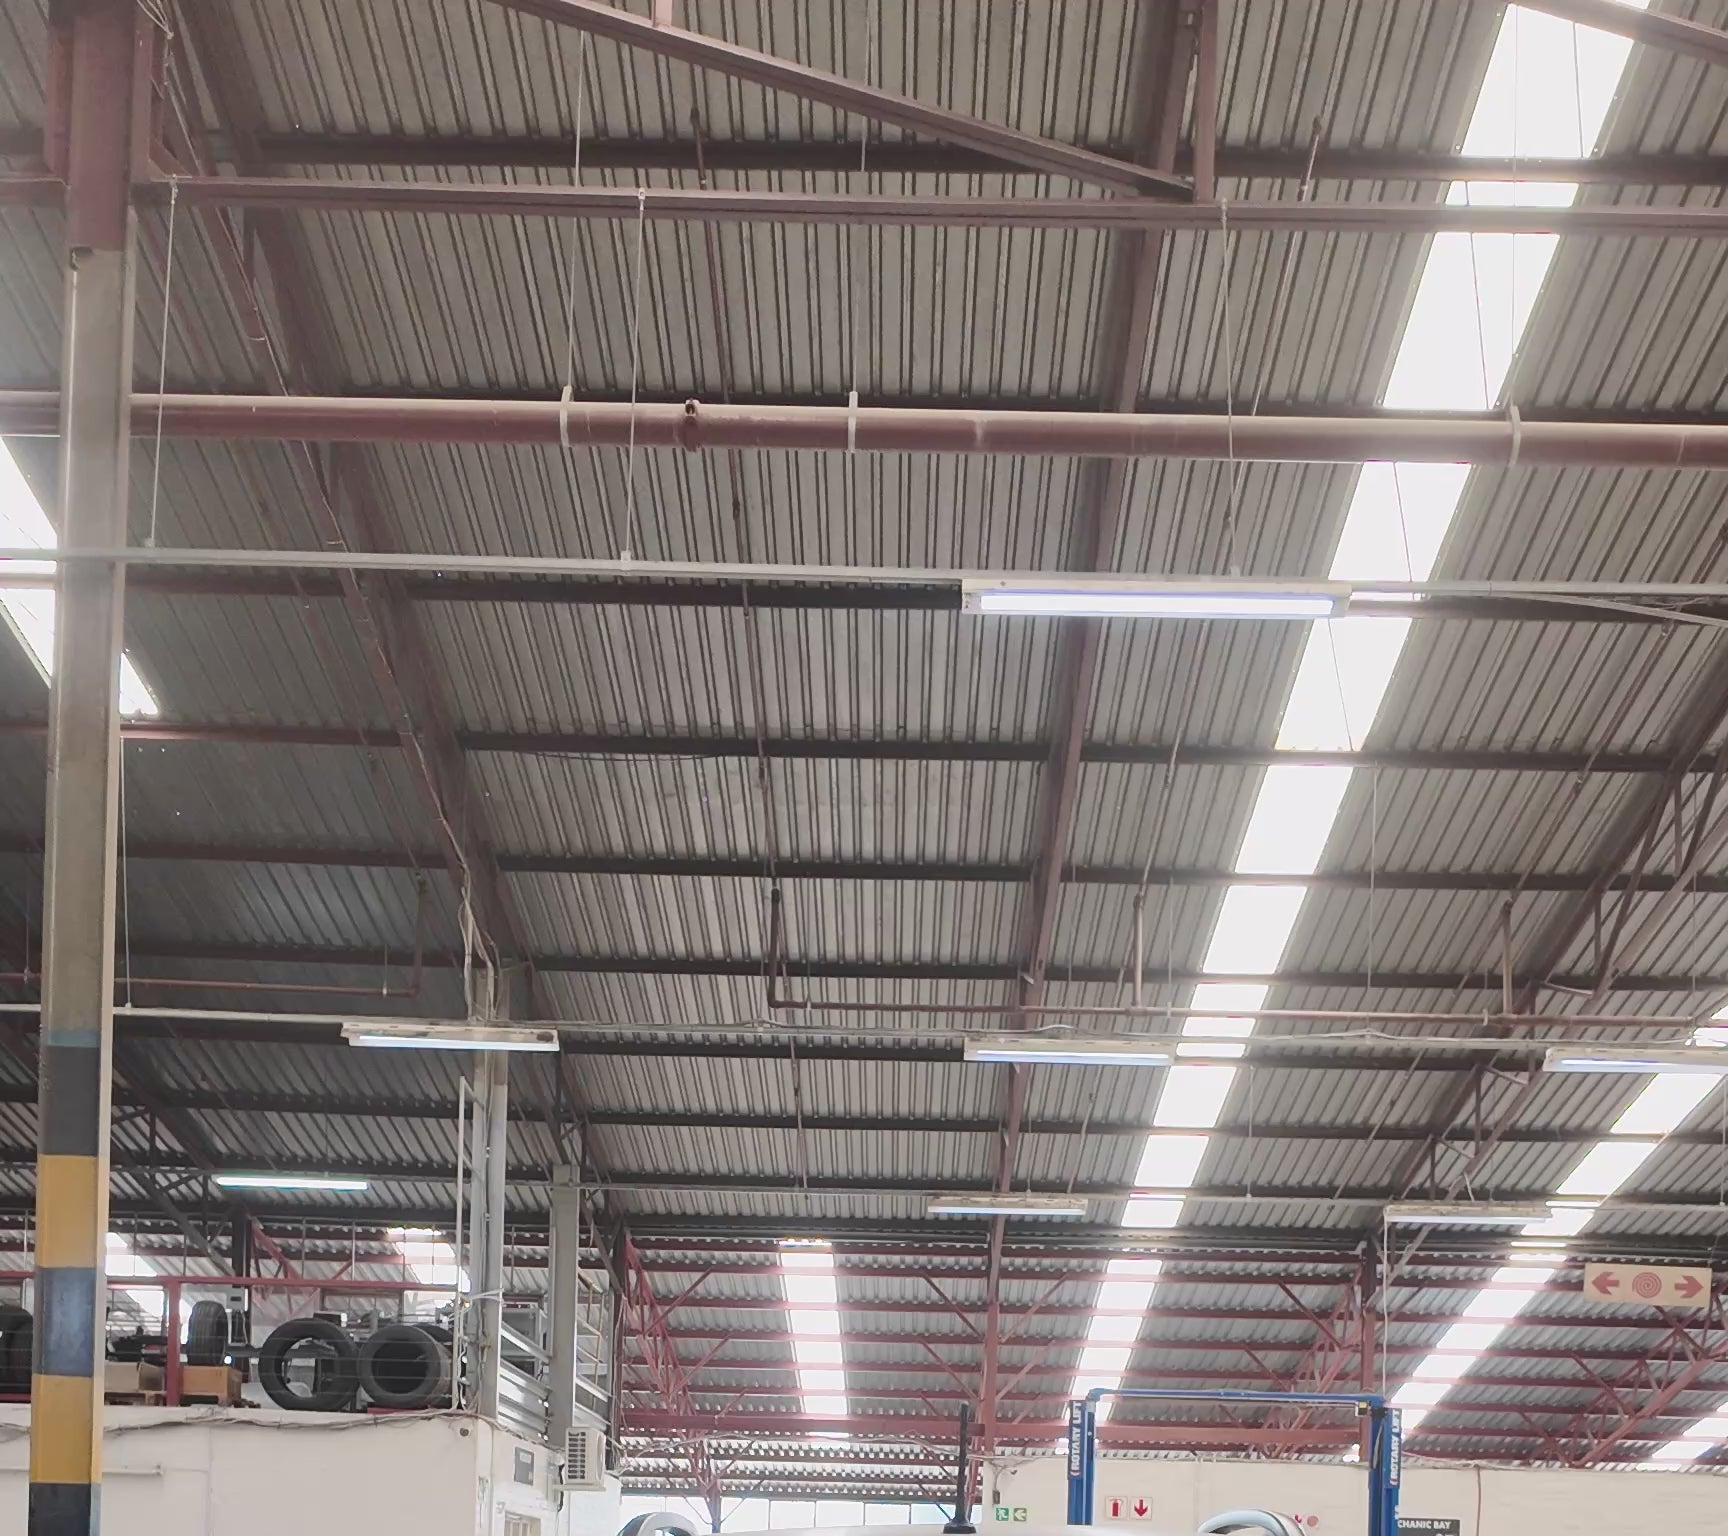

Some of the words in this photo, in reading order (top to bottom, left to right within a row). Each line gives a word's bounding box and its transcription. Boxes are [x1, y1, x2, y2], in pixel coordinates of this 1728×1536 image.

[1072, 1401, 1082, 1424] LIFT
[1070, 1427, 1081, 1471] ROTARY
[1390, 1435, 1399, 1479] ROTARY
[1433, 1521, 1451, 1530] BAY
